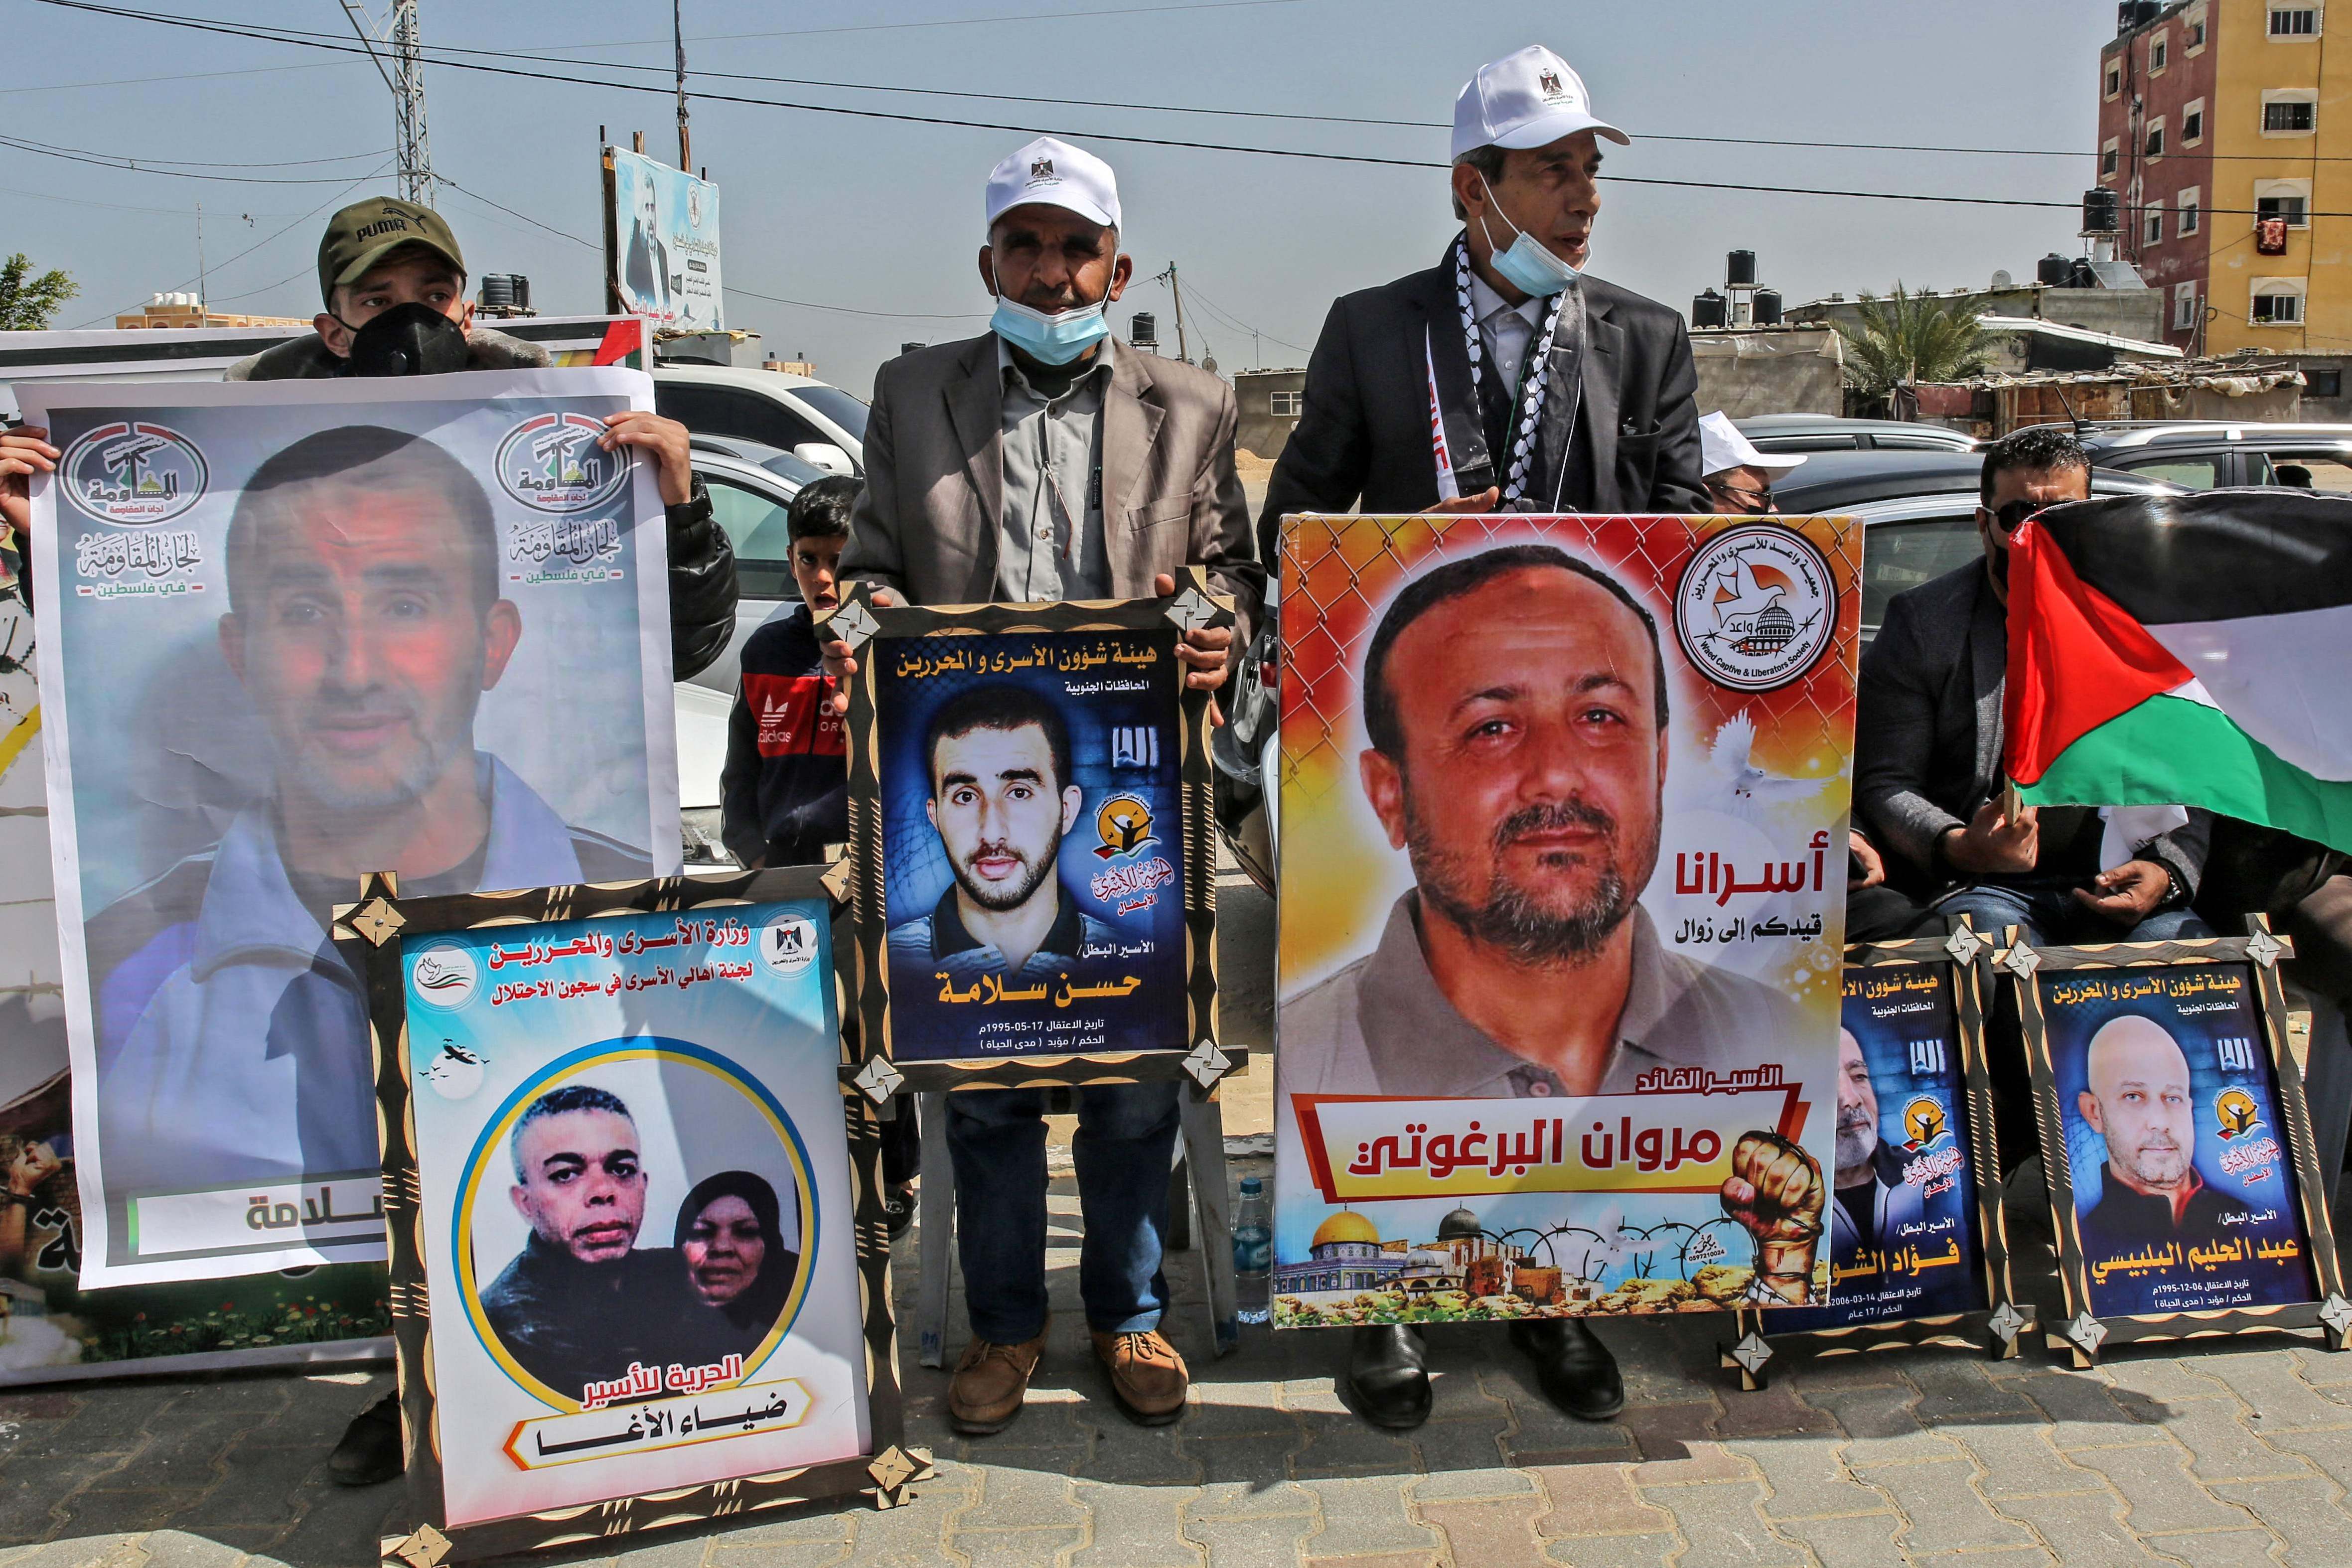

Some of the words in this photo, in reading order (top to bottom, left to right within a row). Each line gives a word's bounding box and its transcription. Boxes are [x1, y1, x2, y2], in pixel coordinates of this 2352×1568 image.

[356, 217, 407, 243] PUMA
[537, 494, 569, 502] المقاومة
[571, 493, 586, 503] لجان
[147, 505, 163, 514] لجان
[1769, 541, 1800, 566] واعد
[526, 570, 578, 583] فلسطين
[582, 569, 605, 581] في
[1691, 552, 1726, 600] والمحررين
[1799, 560, 1819, 599] جمعية
[98, 583, 155, 596] فلسطين
[159, 582, 185, 595] في
[1730, 620, 1753, 634] واعد
[897, 649, 972, 678] المحررين
[977, 657, 987, 674] و
[992, 644, 1053, 674] الأسرى
[1059, 642, 1106, 672] شؤون
[1111, 642, 1157, 669] هيئة
[1700, 641, 1717, 661] Waed
[1716, 657, 1742, 676] Captive
[1751, 660, 1788, 678] Liberators
[1788, 641, 1811, 665] Society
[1065, 681, 1103, 695] الجنوبية
[1106, 680, 1149, 692] المحافظات
[758, 730, 791, 743] didas
[1676, 830, 1829, 907] أسرانا
[618, 916, 700, 957] الأسرى
[706, 918, 751, 946] وزارة
[1675, 917, 1713, 944] زوال
[1719, 917, 1745, 943] إلى
[1751, 913, 1822, 943] قيدكم
[488, 930, 612, 970] والمحررين
[1118, 941, 1154, 959] الأسير
[626, 969, 674, 992] الأسرى
[680, 962, 715, 989] أهالي
[720, 961, 753, 980] لجنة
[491, 983, 554, 1005] الاحتلال
[560, 981, 600, 999] سجون
[605, 975, 620, 997] في
[935, 972, 1046, 1005] سلامة
[1055, 971, 1142, 1007] حسن
[1866, 974, 1901, 998] شؤون
[1904, 973, 1938, 994] هيئة
[2054, 981, 2107, 1005] المحررين
[2111, 987, 2118, 1000] و
[2121, 977, 2166, 1000] الأسرى
[2169, 974, 2205, 998] شؤون
[2206, 974, 2240, 994] هيئة
[1872, 1005, 1900, 1018] الجنوبية
[1901, 1001, 1934, 1013] المحافظات
[2177, 1003, 2205, 1015] الجنوبية
[2206, 1001, 2239, 1011] المحافظات
[1046, 1019, 1081, 1031] الاعتقال
[1084, 1019, 1104, 1030] تاريخ
[1047, 1035, 1069, 1048] مؤبد
[1078, 1035, 1104, 1046] الحكم
[1638, 1068, 1701, 1093] القائد
[1707, 1065, 1781, 1094] الأسير
[1582, 1116, 1721, 1173] مروان
[247, 1186, 385, 1231] لامة
[2250, 1209, 2277, 1224] الأسير
[1927, 1217, 1954, 1235] الأسير
[1688, 1249, 1725, 1261] 0597210024
[1893, 1237, 1960, 1276] فؤاد
[2188, 1236, 2250, 1273] الحليم
[2257, 1237, 2299, 1266] عبد
[1830, 1246, 1886, 1286] الشو
[2091, 1242, 2182, 1285] البلبيسي
[1906, 1287, 1921, 1298] تاريخ
[2204, 1280, 2232, 1290] الاعتقال
[2234, 1279, 2249, 1289] تاريخ
[1877, 1289, 1904, 1302] الاعتقال
[2207, 1295, 2224, 1305] مؤبد
[2231, 1293, 2251, 1303] الحكم
[1848, 1310, 1863, 1320] عام
[1882, 1304, 1902, 1315] الحكم
[669, 1355, 741, 1391] الحرية
[584, 1362, 659, 1408] للأسير
[681, 1392, 787, 1438] ضياء
